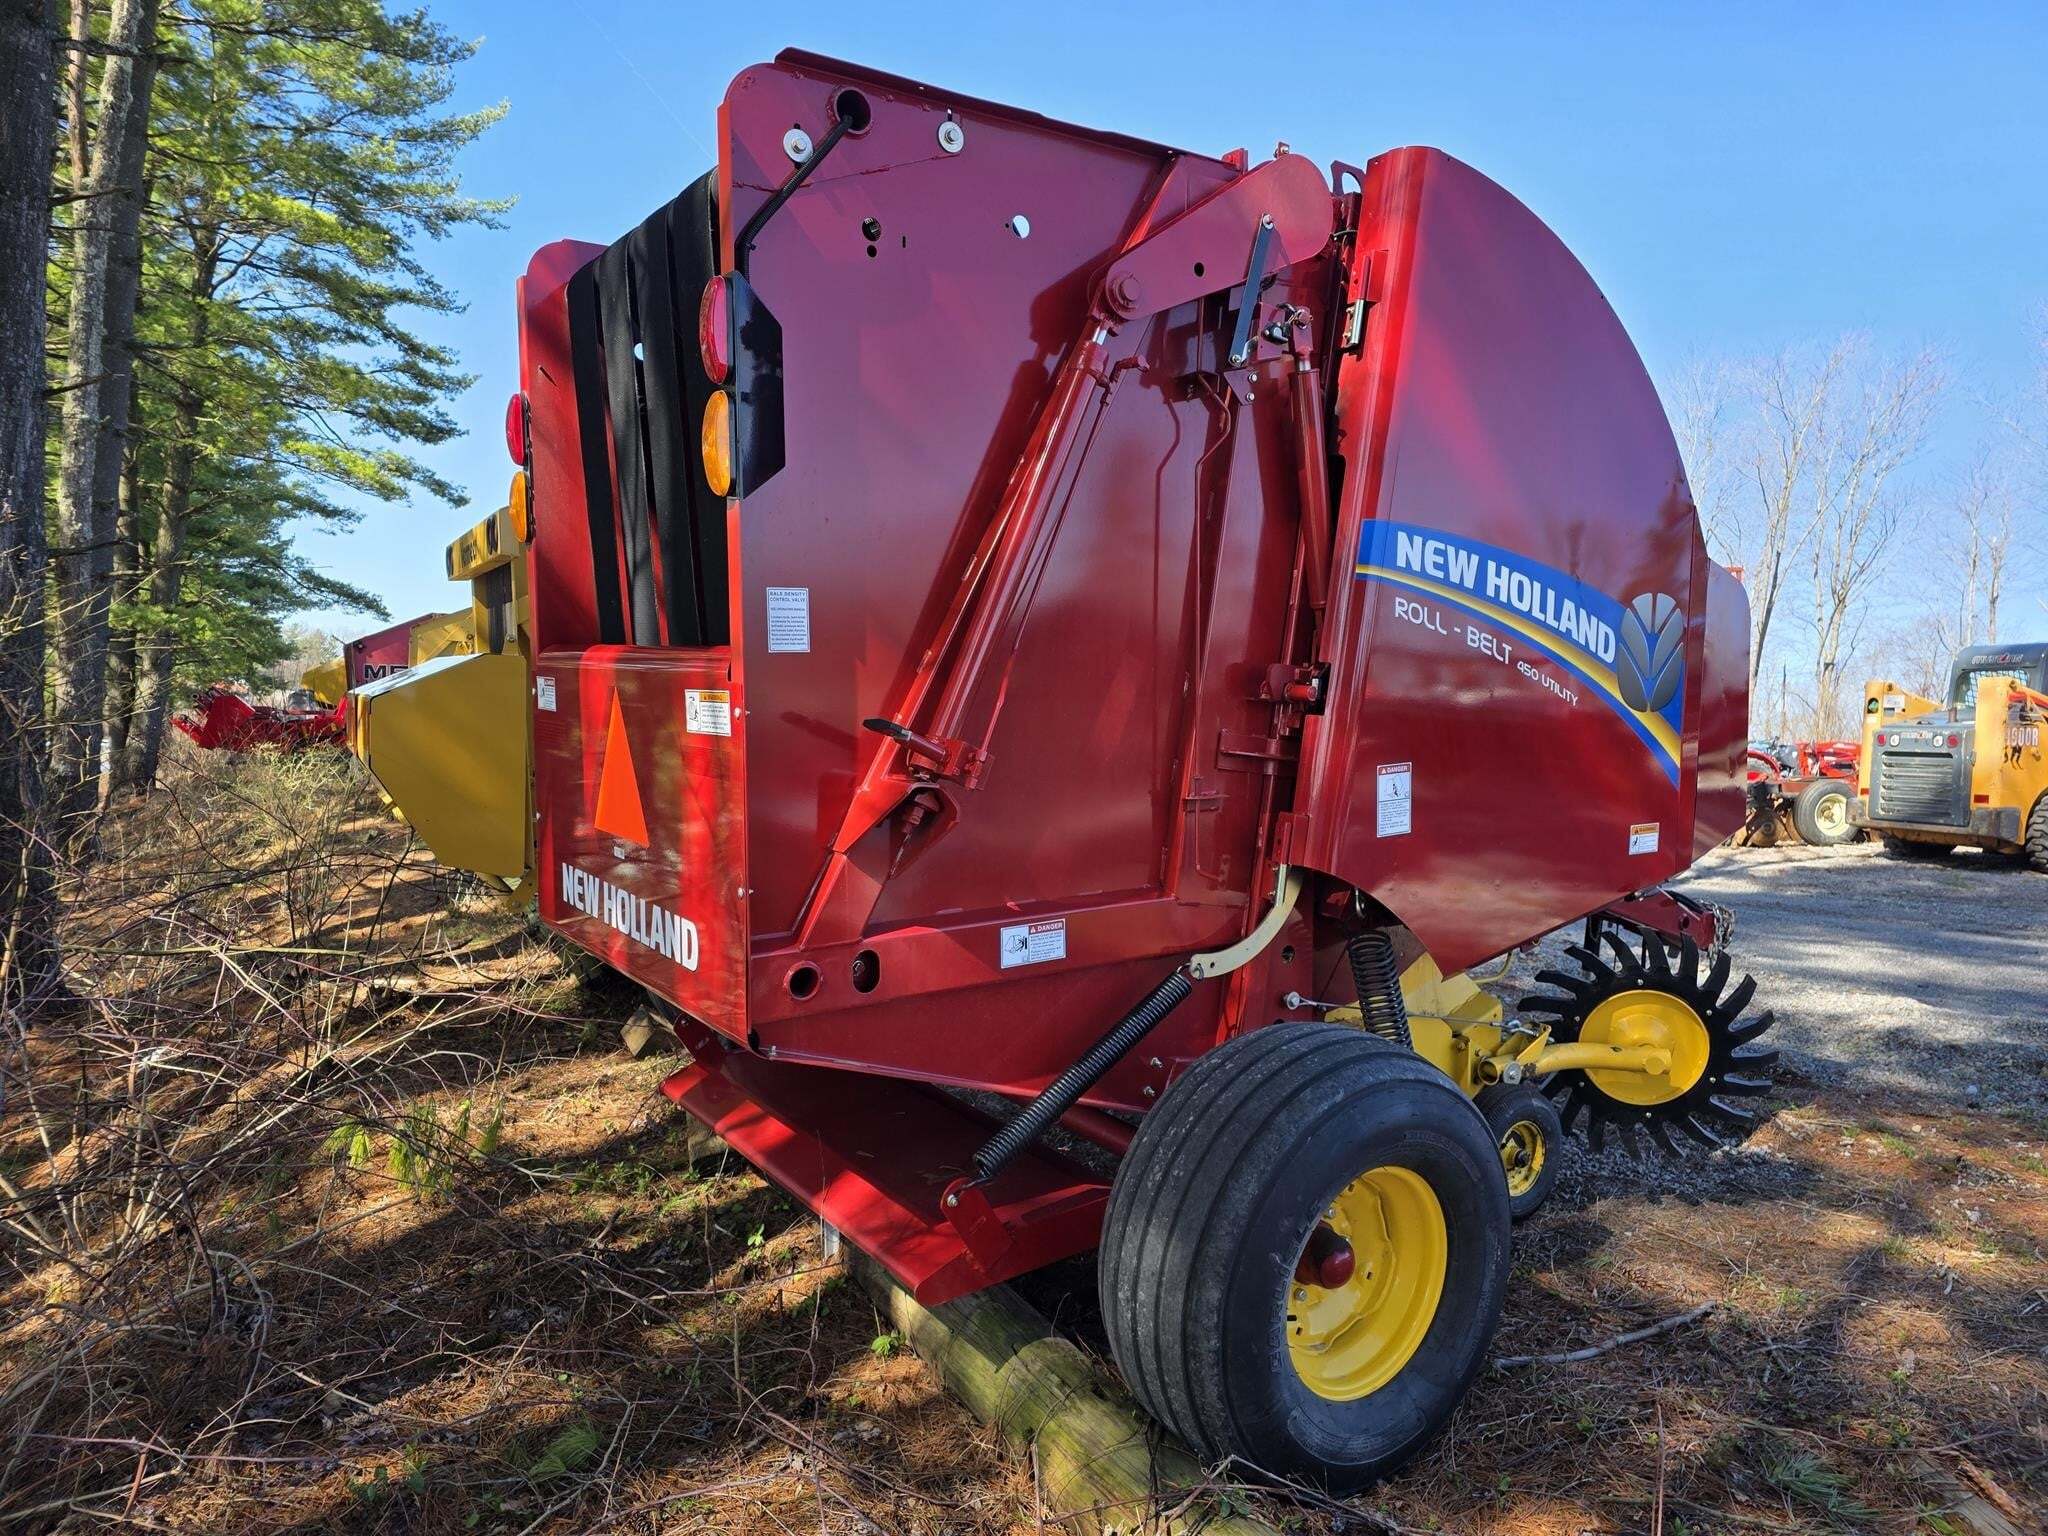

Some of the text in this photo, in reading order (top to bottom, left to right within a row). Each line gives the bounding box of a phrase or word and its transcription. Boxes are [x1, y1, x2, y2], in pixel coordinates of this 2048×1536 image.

[1394, 596, 1448, 636] ROLL
[1466, 625, 1513, 665] BELT
[1516, 660, 1540, 681] 450
[1541, 673, 1579, 707] UTILITY
[1396, 530, 1616, 664] NEW HOLLAND
[1386, 765, 1408, 774] DANGER
[562, 862, 699, 972] NEW HOLLAND
[1037, 922, 1063, 931] DANGER
